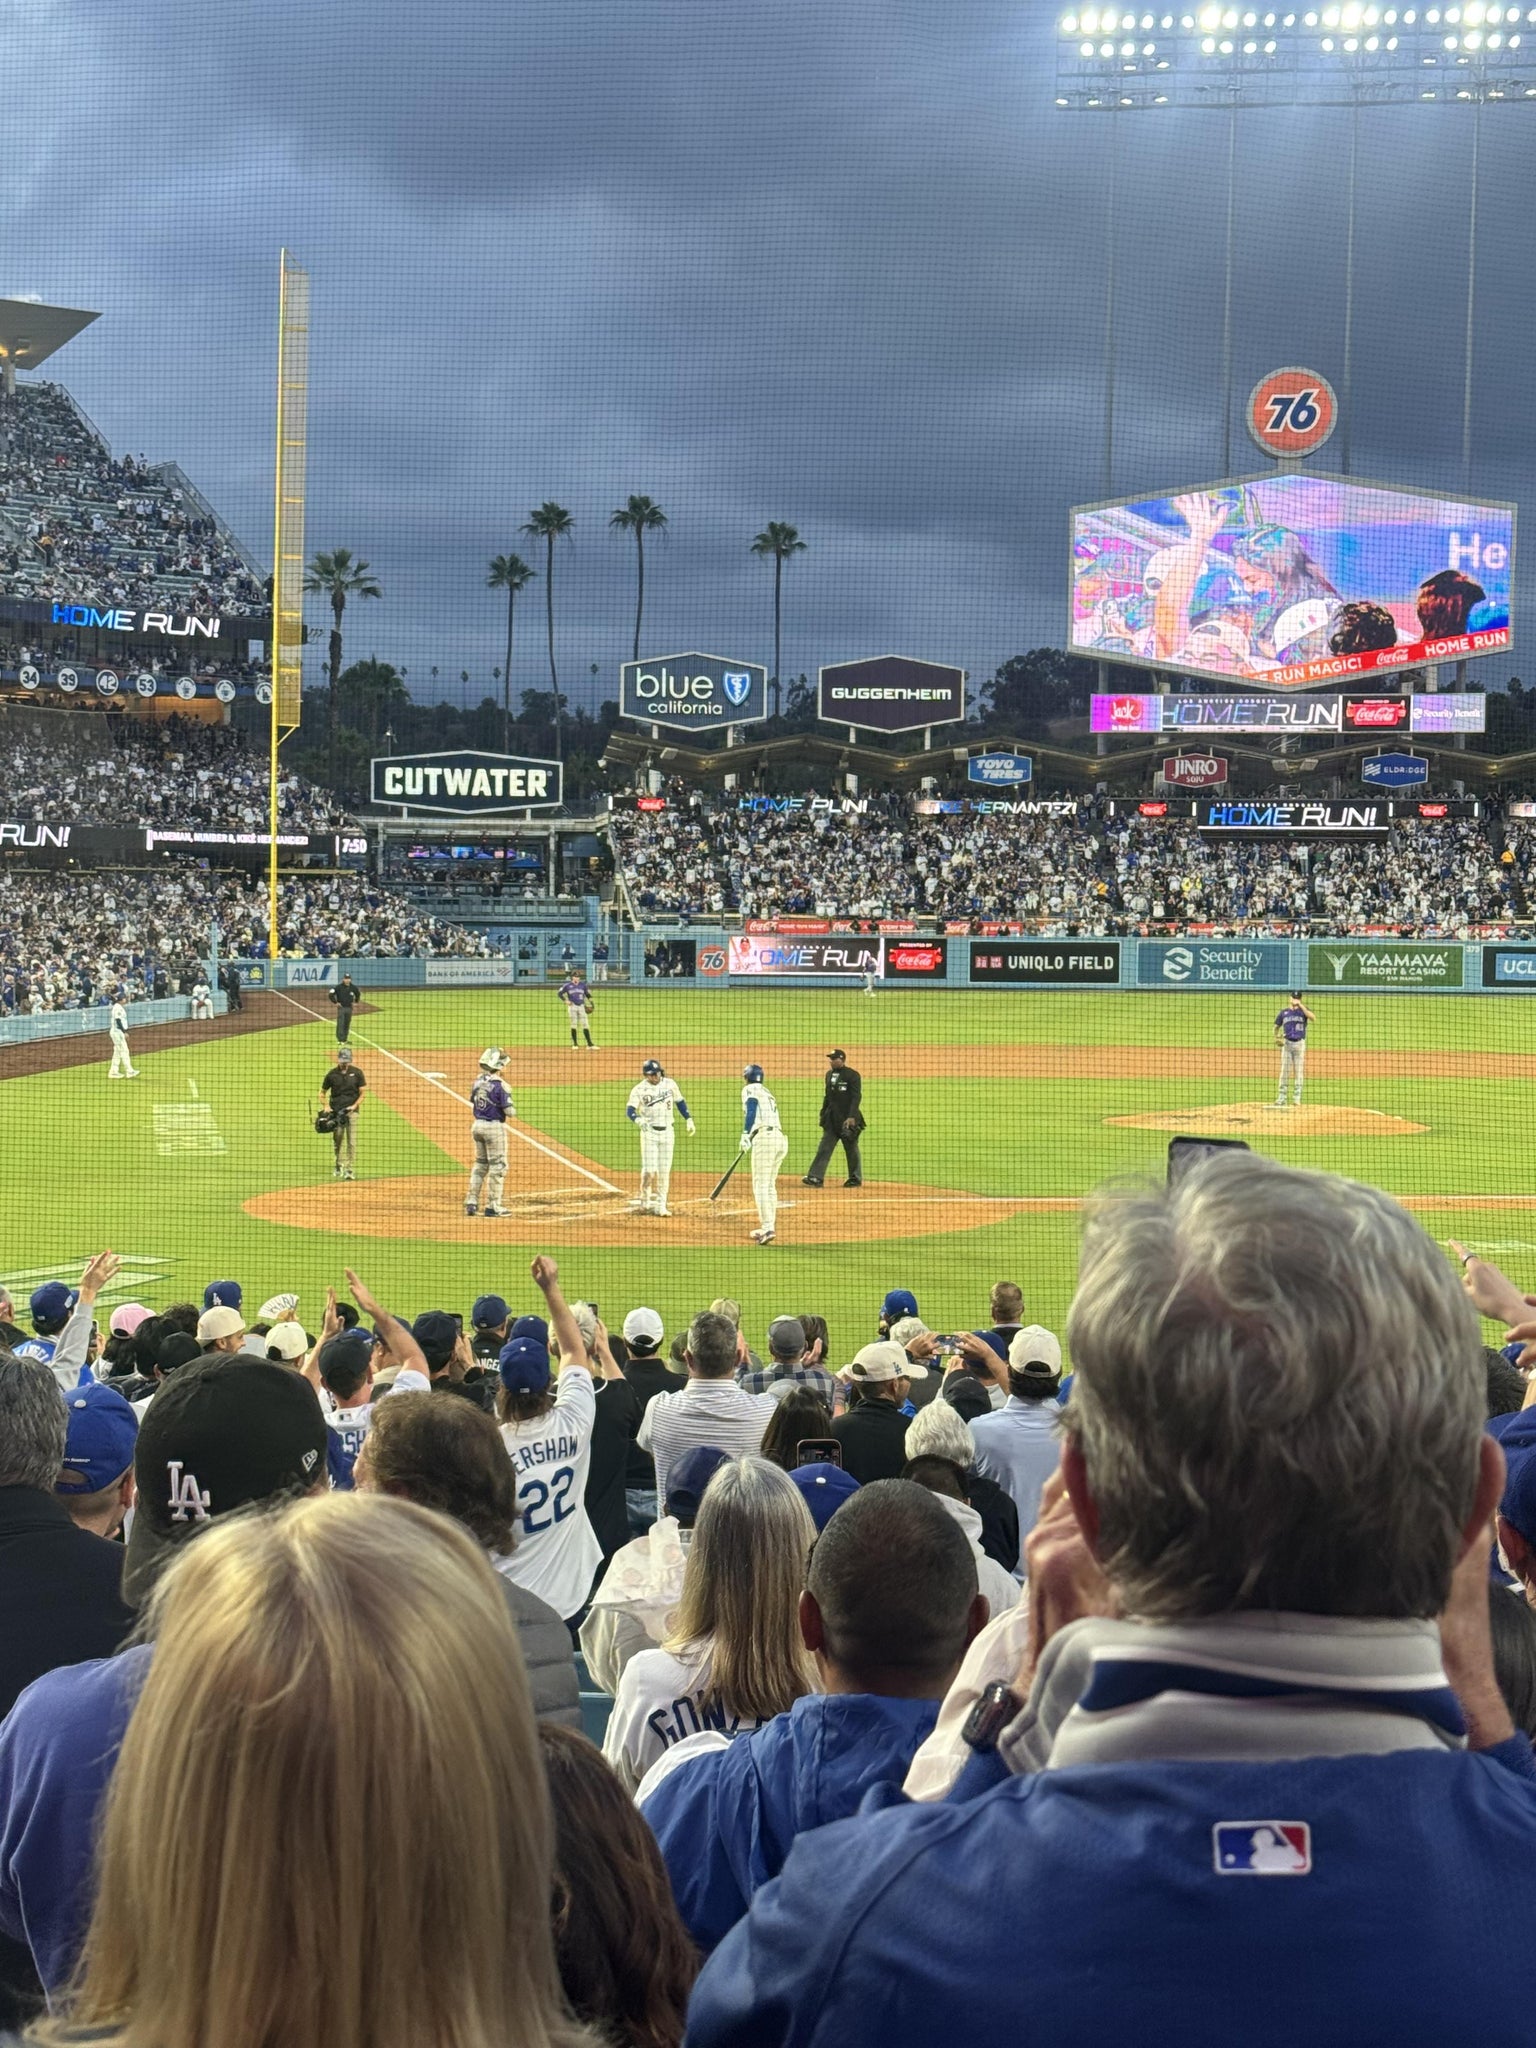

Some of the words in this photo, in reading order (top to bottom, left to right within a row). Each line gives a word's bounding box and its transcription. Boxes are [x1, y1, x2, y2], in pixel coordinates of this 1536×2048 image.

[1263, 388, 1321, 433] 76
[1448, 532, 1507, 570] He
[53, 604, 136, 631] HOME
[143, 612, 220, 638] RUN!
[1425, 640, 1469, 657] HOME
[1474, 631, 1507, 650] RUN
[22, 669, 38, 686] 34
[61, 671, 76, 688] 39
[1273, 669, 1305, 684] RUN
[1309, 657, 1362, 676] MAGIC!
[99, 674, 117, 691] 42
[139, 678, 154, 693] 53
[636, 667, 714, 699] blue
[831, 687, 952, 700] GUGGENHEIM
[647, 700, 723, 715] california
[1111, 701, 1142, 721] Jack
[1265, 703, 1338, 724] RUN
[976, 759, 1015, 770] TOYO
[982, 769, 1024, 779] TIRES
[1172, 759, 1218, 780] JINRO
[385, 766, 548, 797] CUTWATER
[1208, 807, 1295, 825] HOME
[1301, 807, 1377, 826] RUN!
[0, 824, 70, 847] RUN!
[342, 838, 368, 853] 7:50
[701, 951, 725, 970] 76
[753, 949, 818, 967] OME
[1008, 956, 1064, 971] UNIQLO
[1068, 956, 1114, 970] FIELD
[1200, 948, 1262, 967] Security
[293, 966, 318, 982] ANA
[428, 970, 449, 978] BANK
[460, 969, 496, 978] AMERICA
[1200, 965, 1256, 980] Benefit
[1360, 967, 1398, 975] RESORT
[1408, 967, 1447, 976] CASINO
[510, 1434, 578, 1475] ERSHAW
[167, 1460, 211, 1521] LA
[518, 1465, 576, 1534] 22
